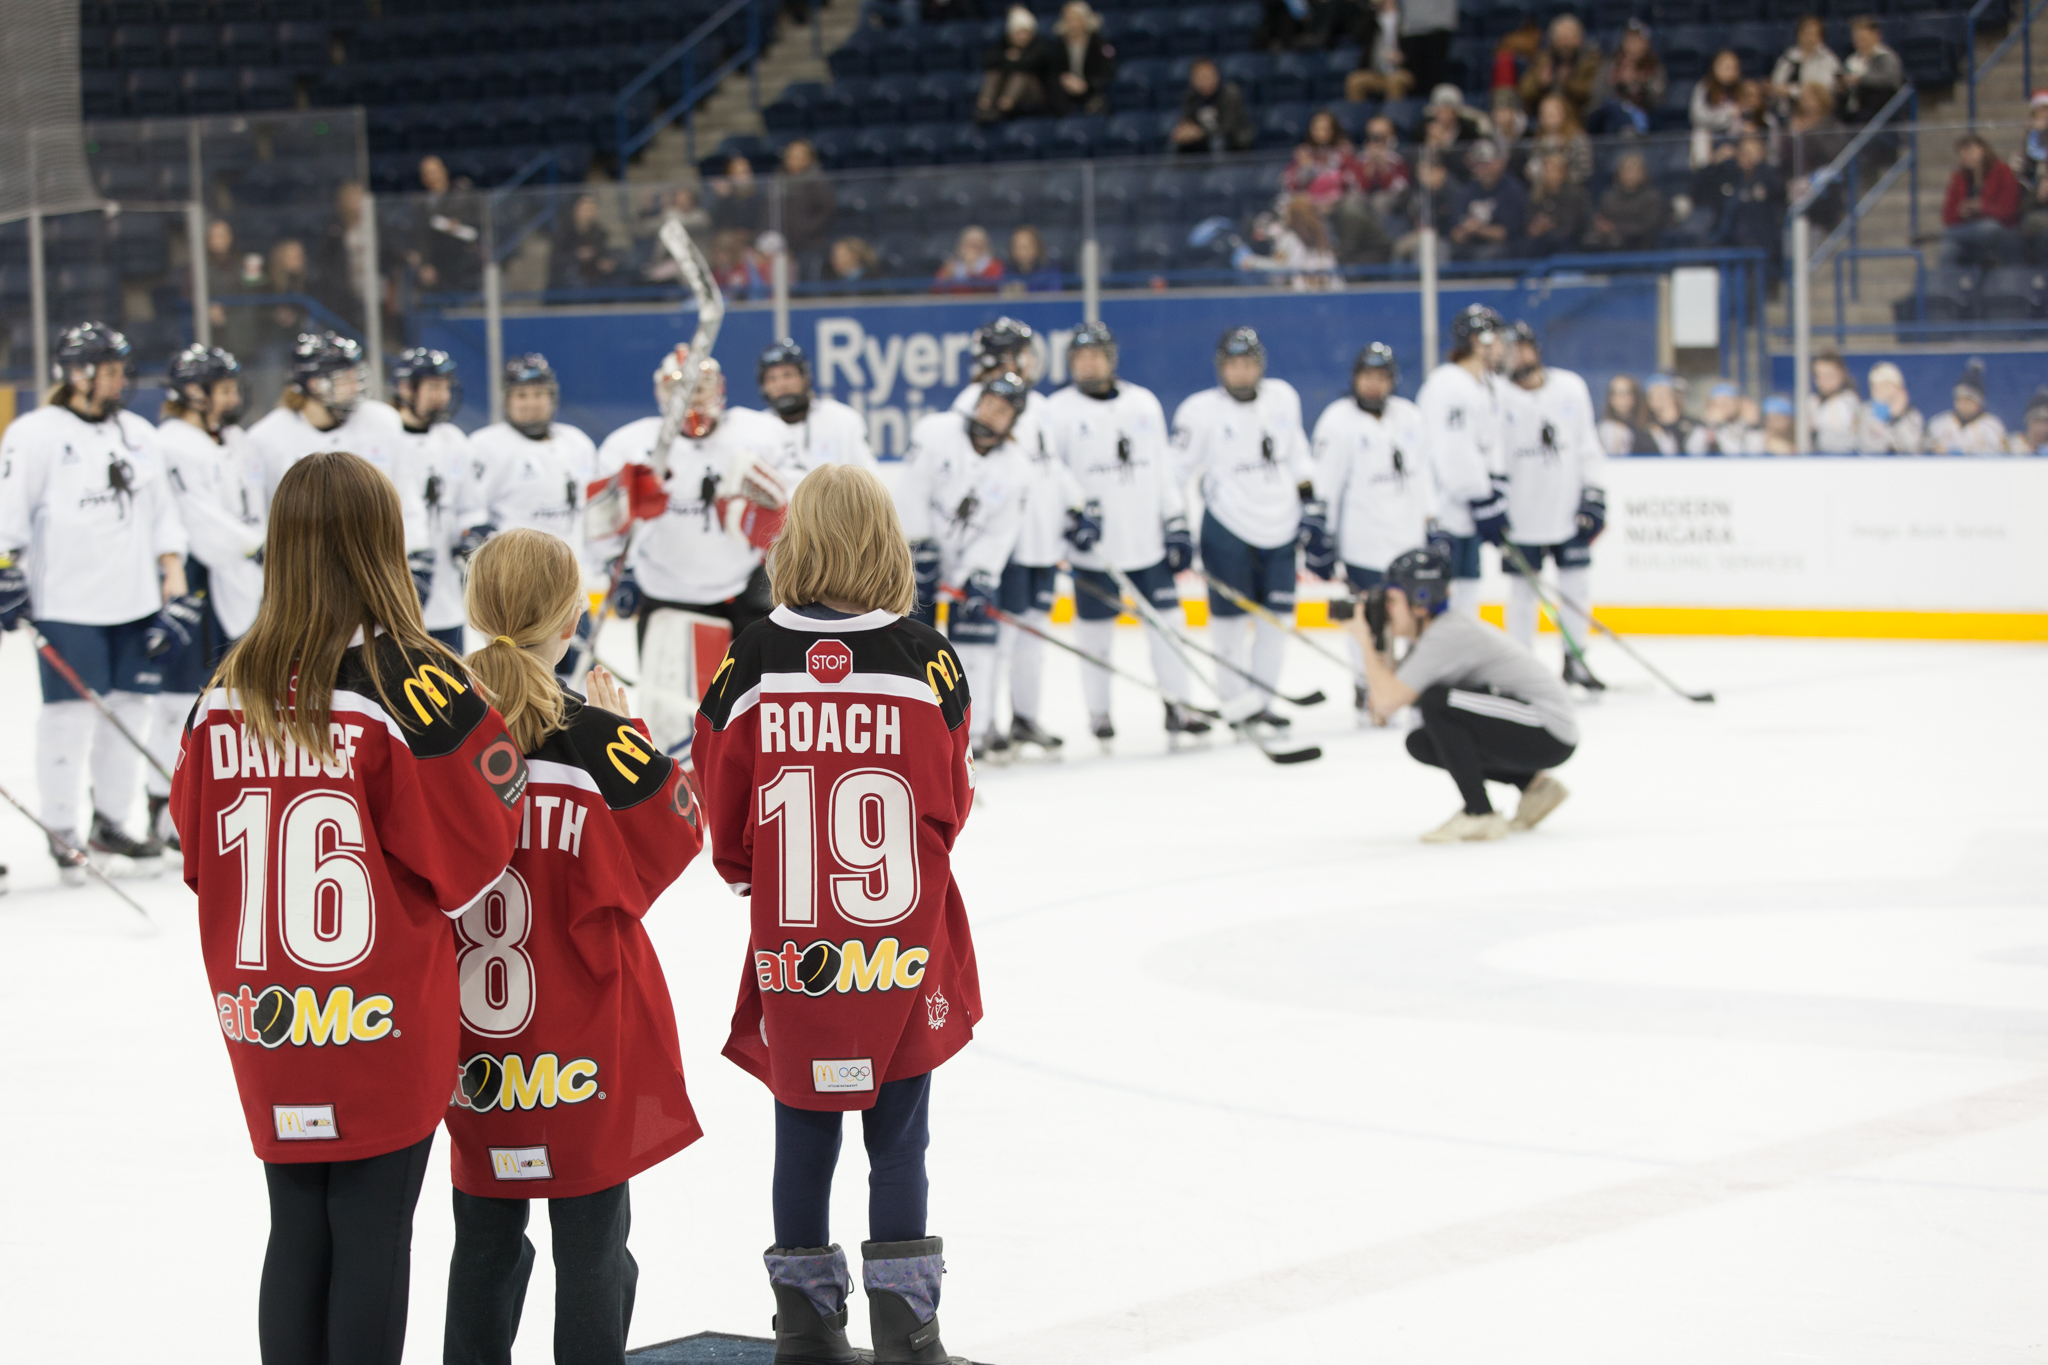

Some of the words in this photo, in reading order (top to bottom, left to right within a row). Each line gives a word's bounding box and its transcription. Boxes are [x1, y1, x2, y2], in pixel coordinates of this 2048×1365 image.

[1625, 498, 1732, 518] MODERN
[1625, 525, 1735, 545] NIAGARA
[811, 654, 848, 671] STOP
[760, 701, 900, 755] ROACH
[503, 786, 516, 801] TRUE
[514, 769, 527, 788] SPORT
[515, 795, 588, 858] ITH
[758, 765, 921, 928] 19
[217, 787, 376, 972] 16
[455, 865, 537, 1039] 8
